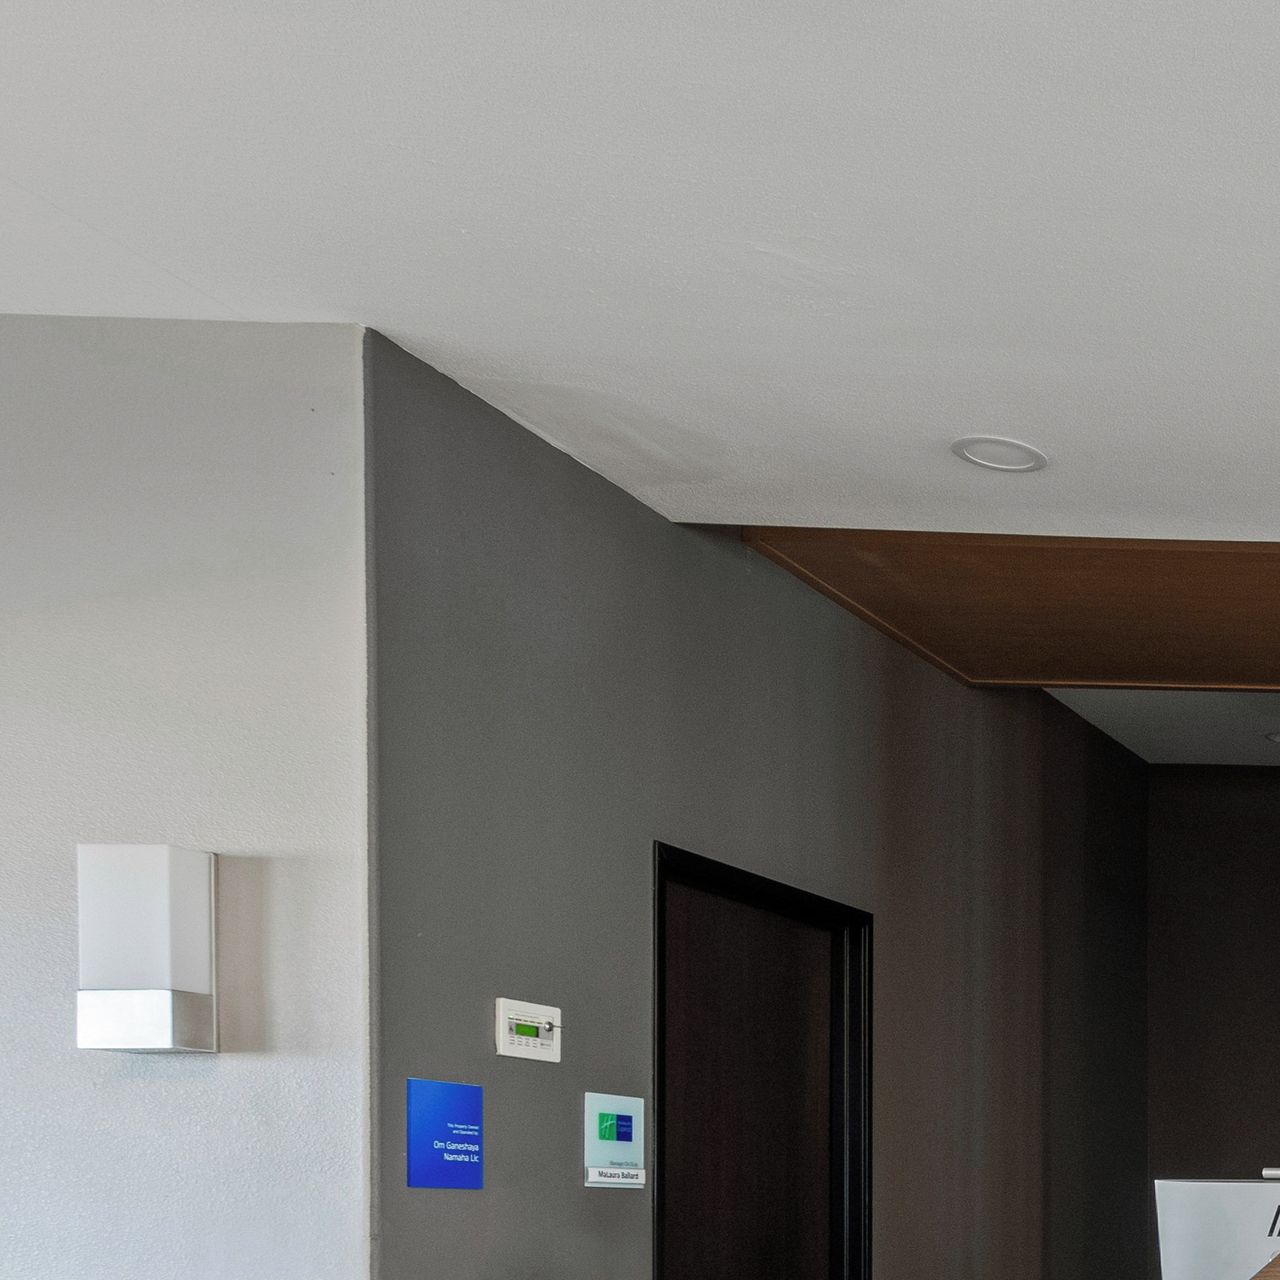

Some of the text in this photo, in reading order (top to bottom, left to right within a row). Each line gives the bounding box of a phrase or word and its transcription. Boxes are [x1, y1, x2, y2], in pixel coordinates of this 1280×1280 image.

[433, 1141, 479, 1152] Om Ganeshaya
[444, 1152, 469, 1162] Namaha
